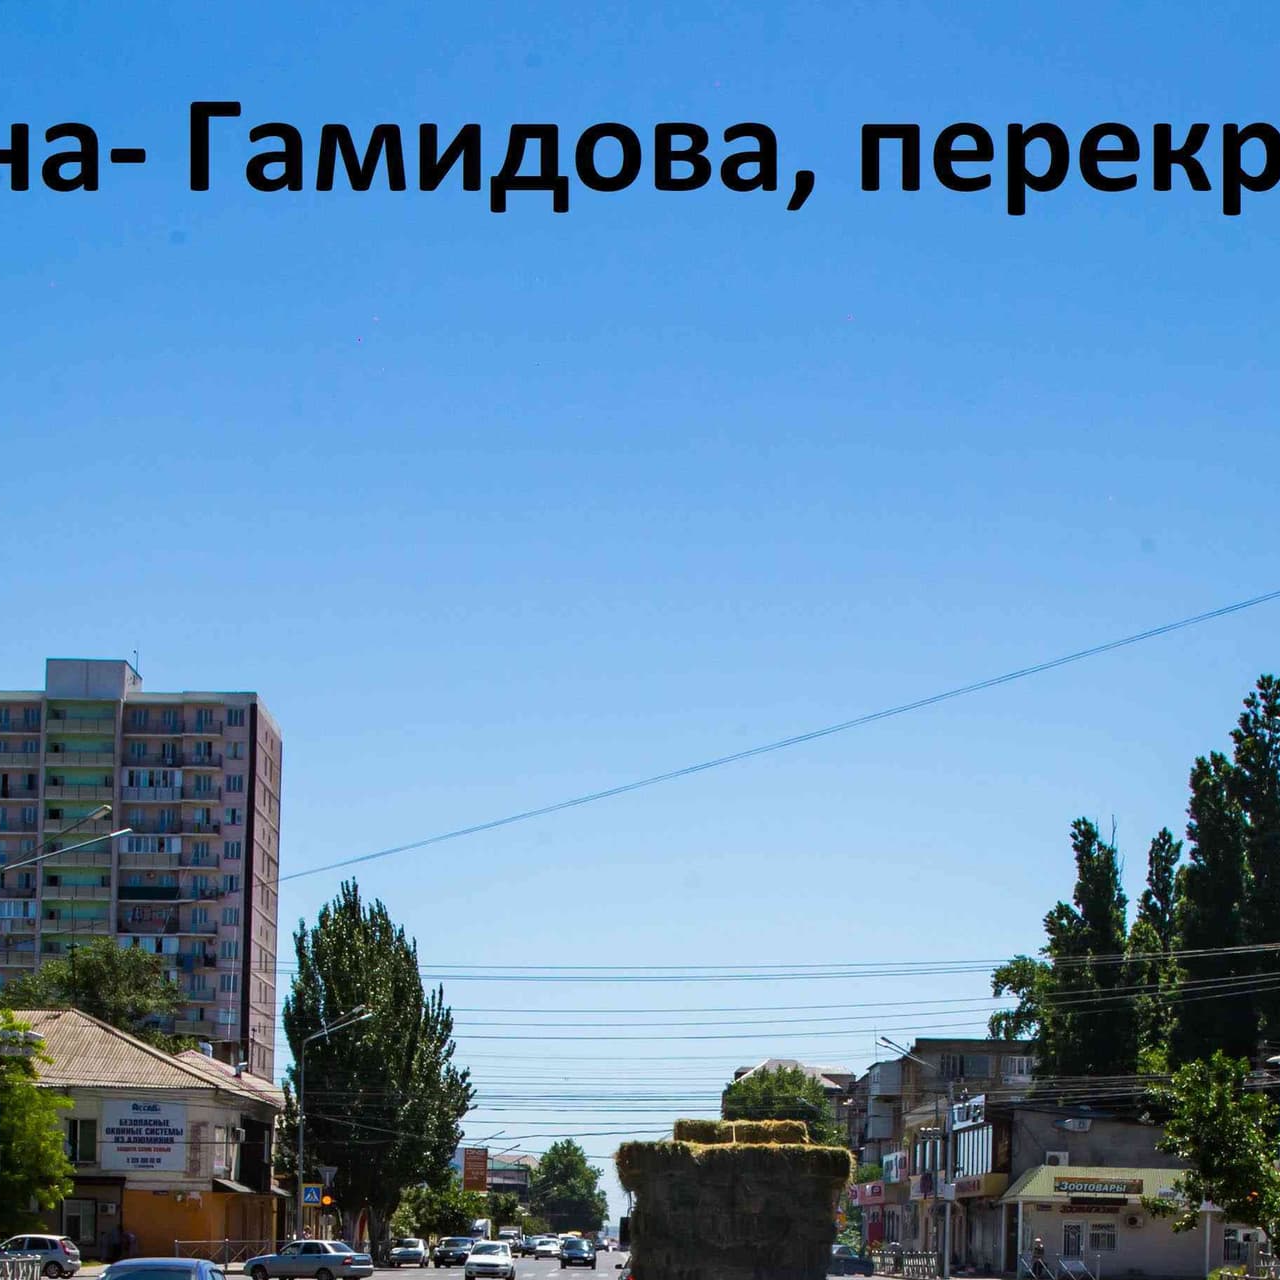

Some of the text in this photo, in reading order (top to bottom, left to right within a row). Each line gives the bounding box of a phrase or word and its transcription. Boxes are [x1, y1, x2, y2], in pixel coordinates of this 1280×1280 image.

[119, 1119, 169, 1127] БЕЗОПАСНЫЕ
[105, 1127, 183, 1136] ОКОННЫЕ СИСТЕМЫ
